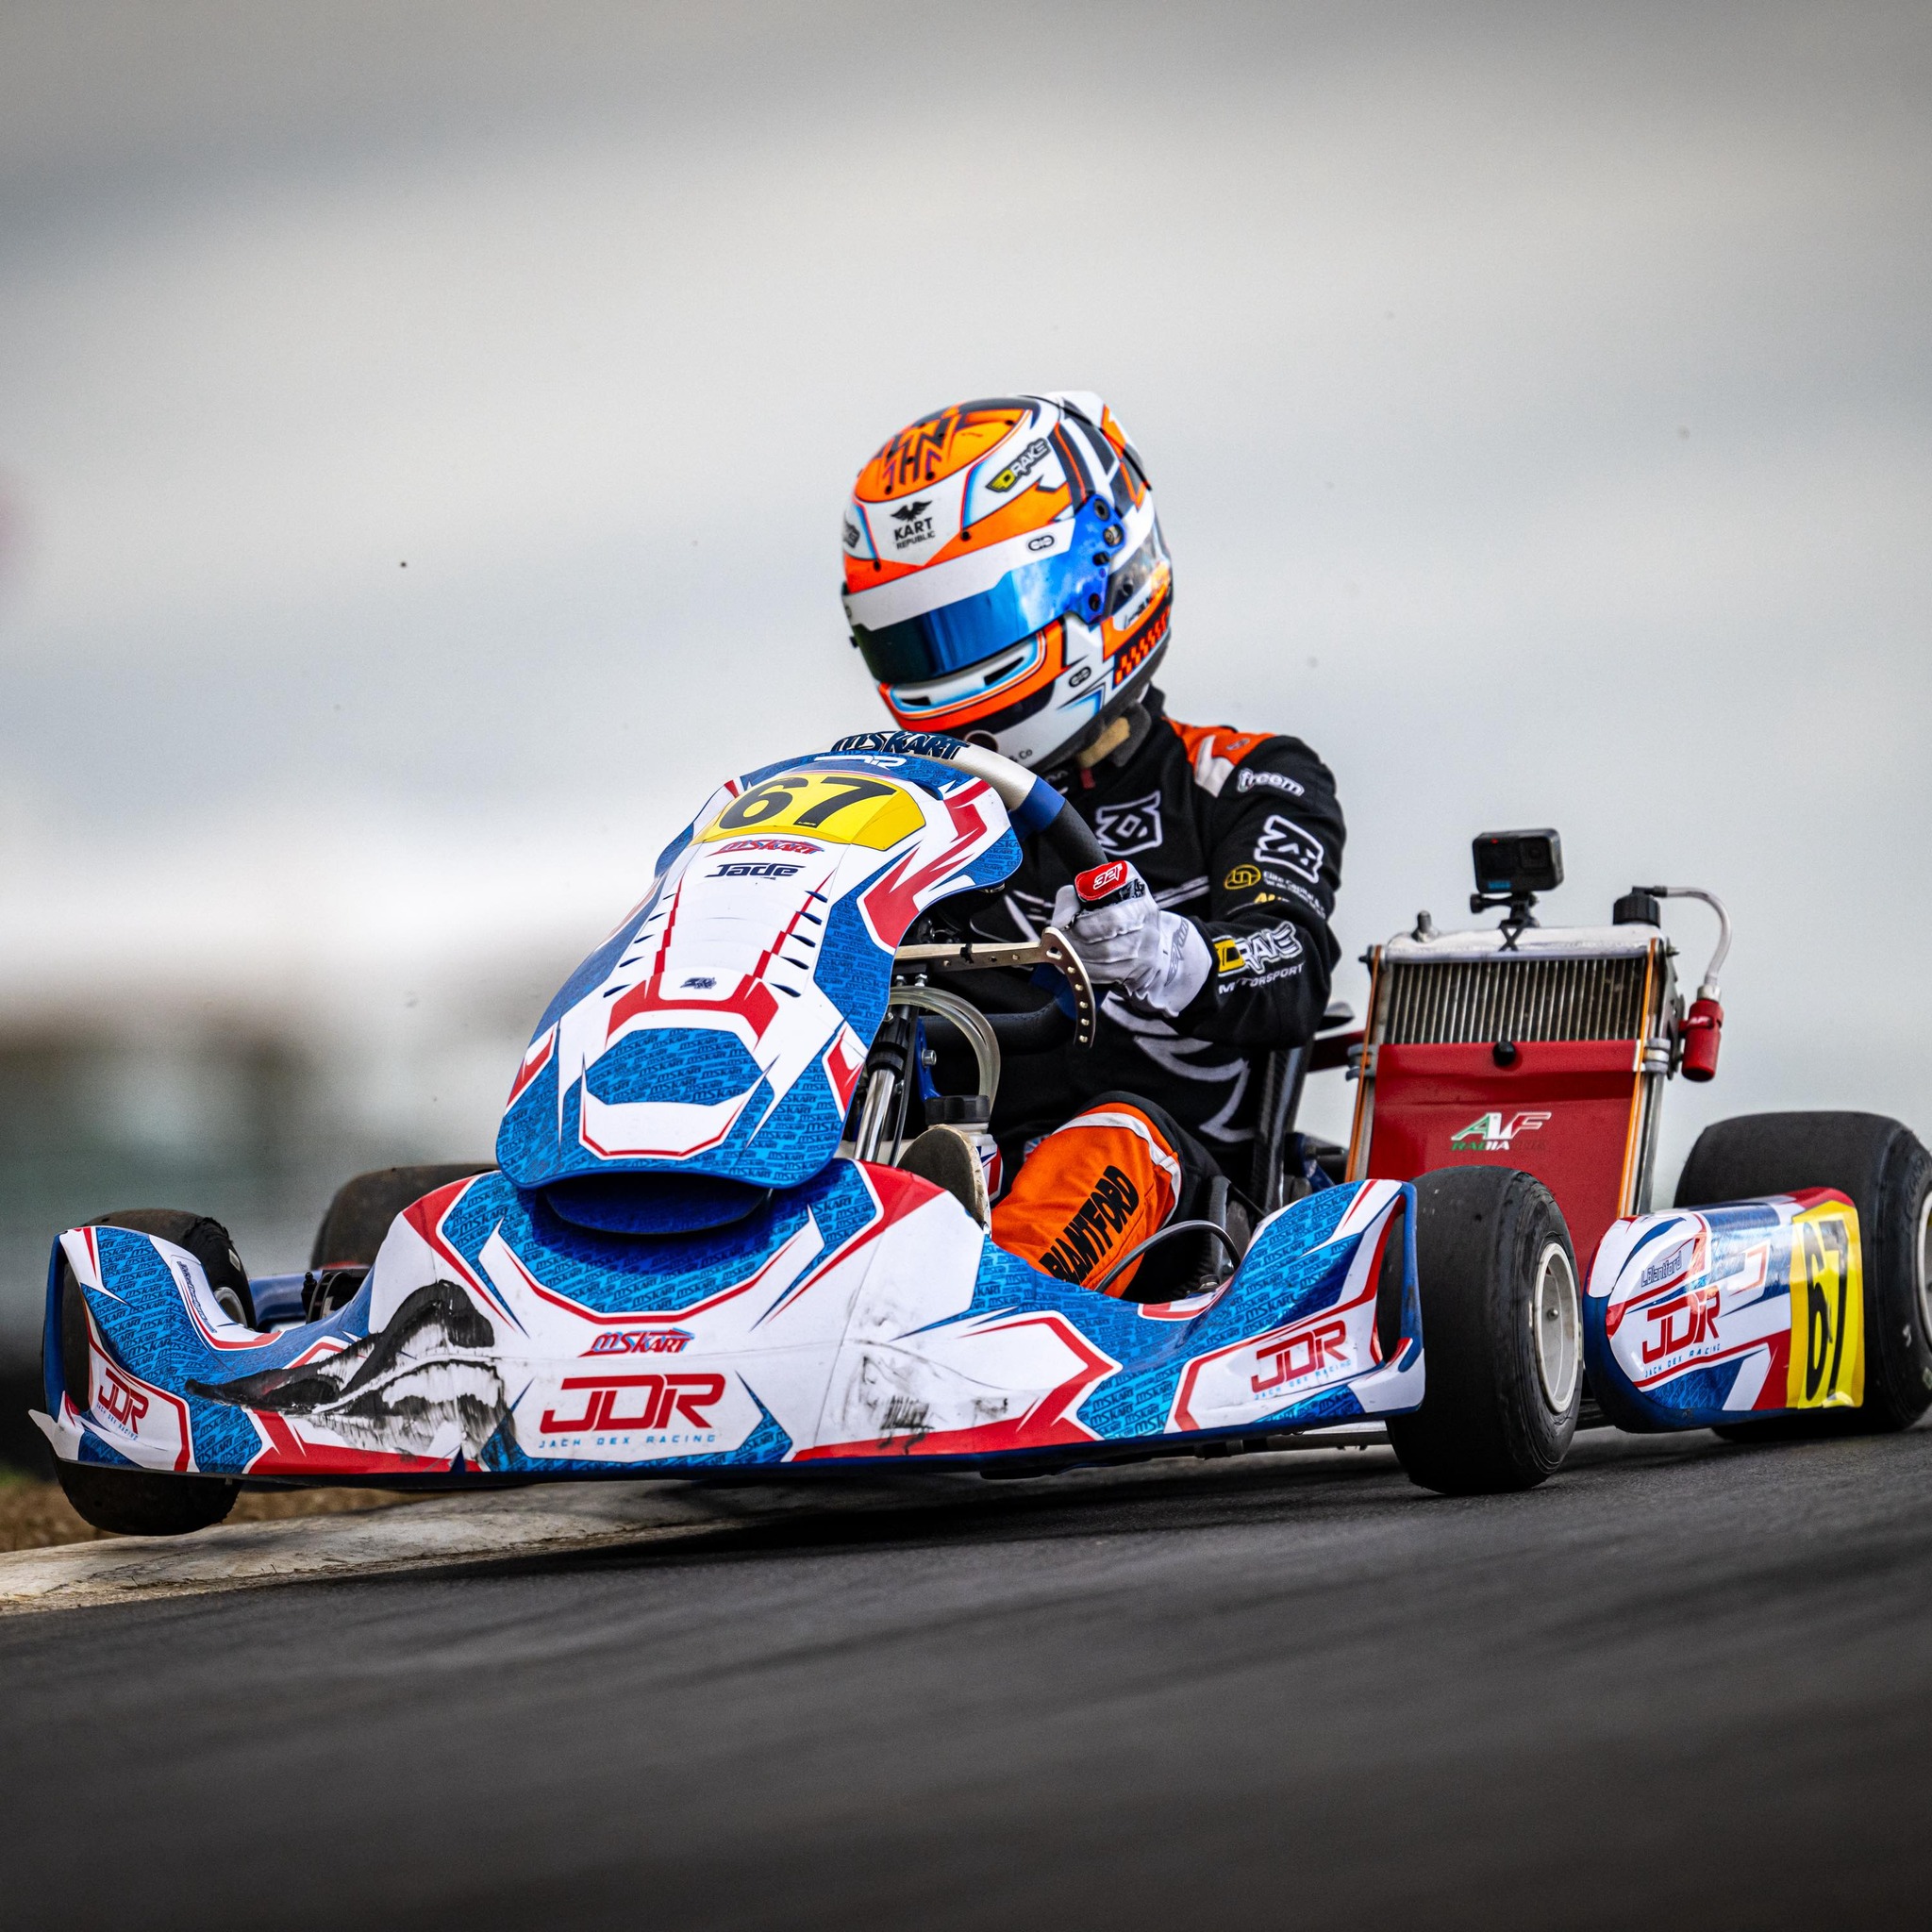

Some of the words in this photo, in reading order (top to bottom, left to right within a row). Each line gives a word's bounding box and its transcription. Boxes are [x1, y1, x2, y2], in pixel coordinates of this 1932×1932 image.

[989, 441, 1049, 491] DRAKE
[894, 517, 933, 541] KART
[896, 531, 936, 550] REPUBLIC
[719, 776, 897, 829] 67
[1218, 960, 1306, 994] MTORSPORT
[1642, 1286, 1720, 1364] JDR
[1251, 1320, 1348, 1393] JDR
[98, 1367, 149, 1435] JDR
[540, 1374, 726, 1434] JDR
[597, 1437, 630, 1446] DEX
[646, 1434, 717, 1444] RACING
